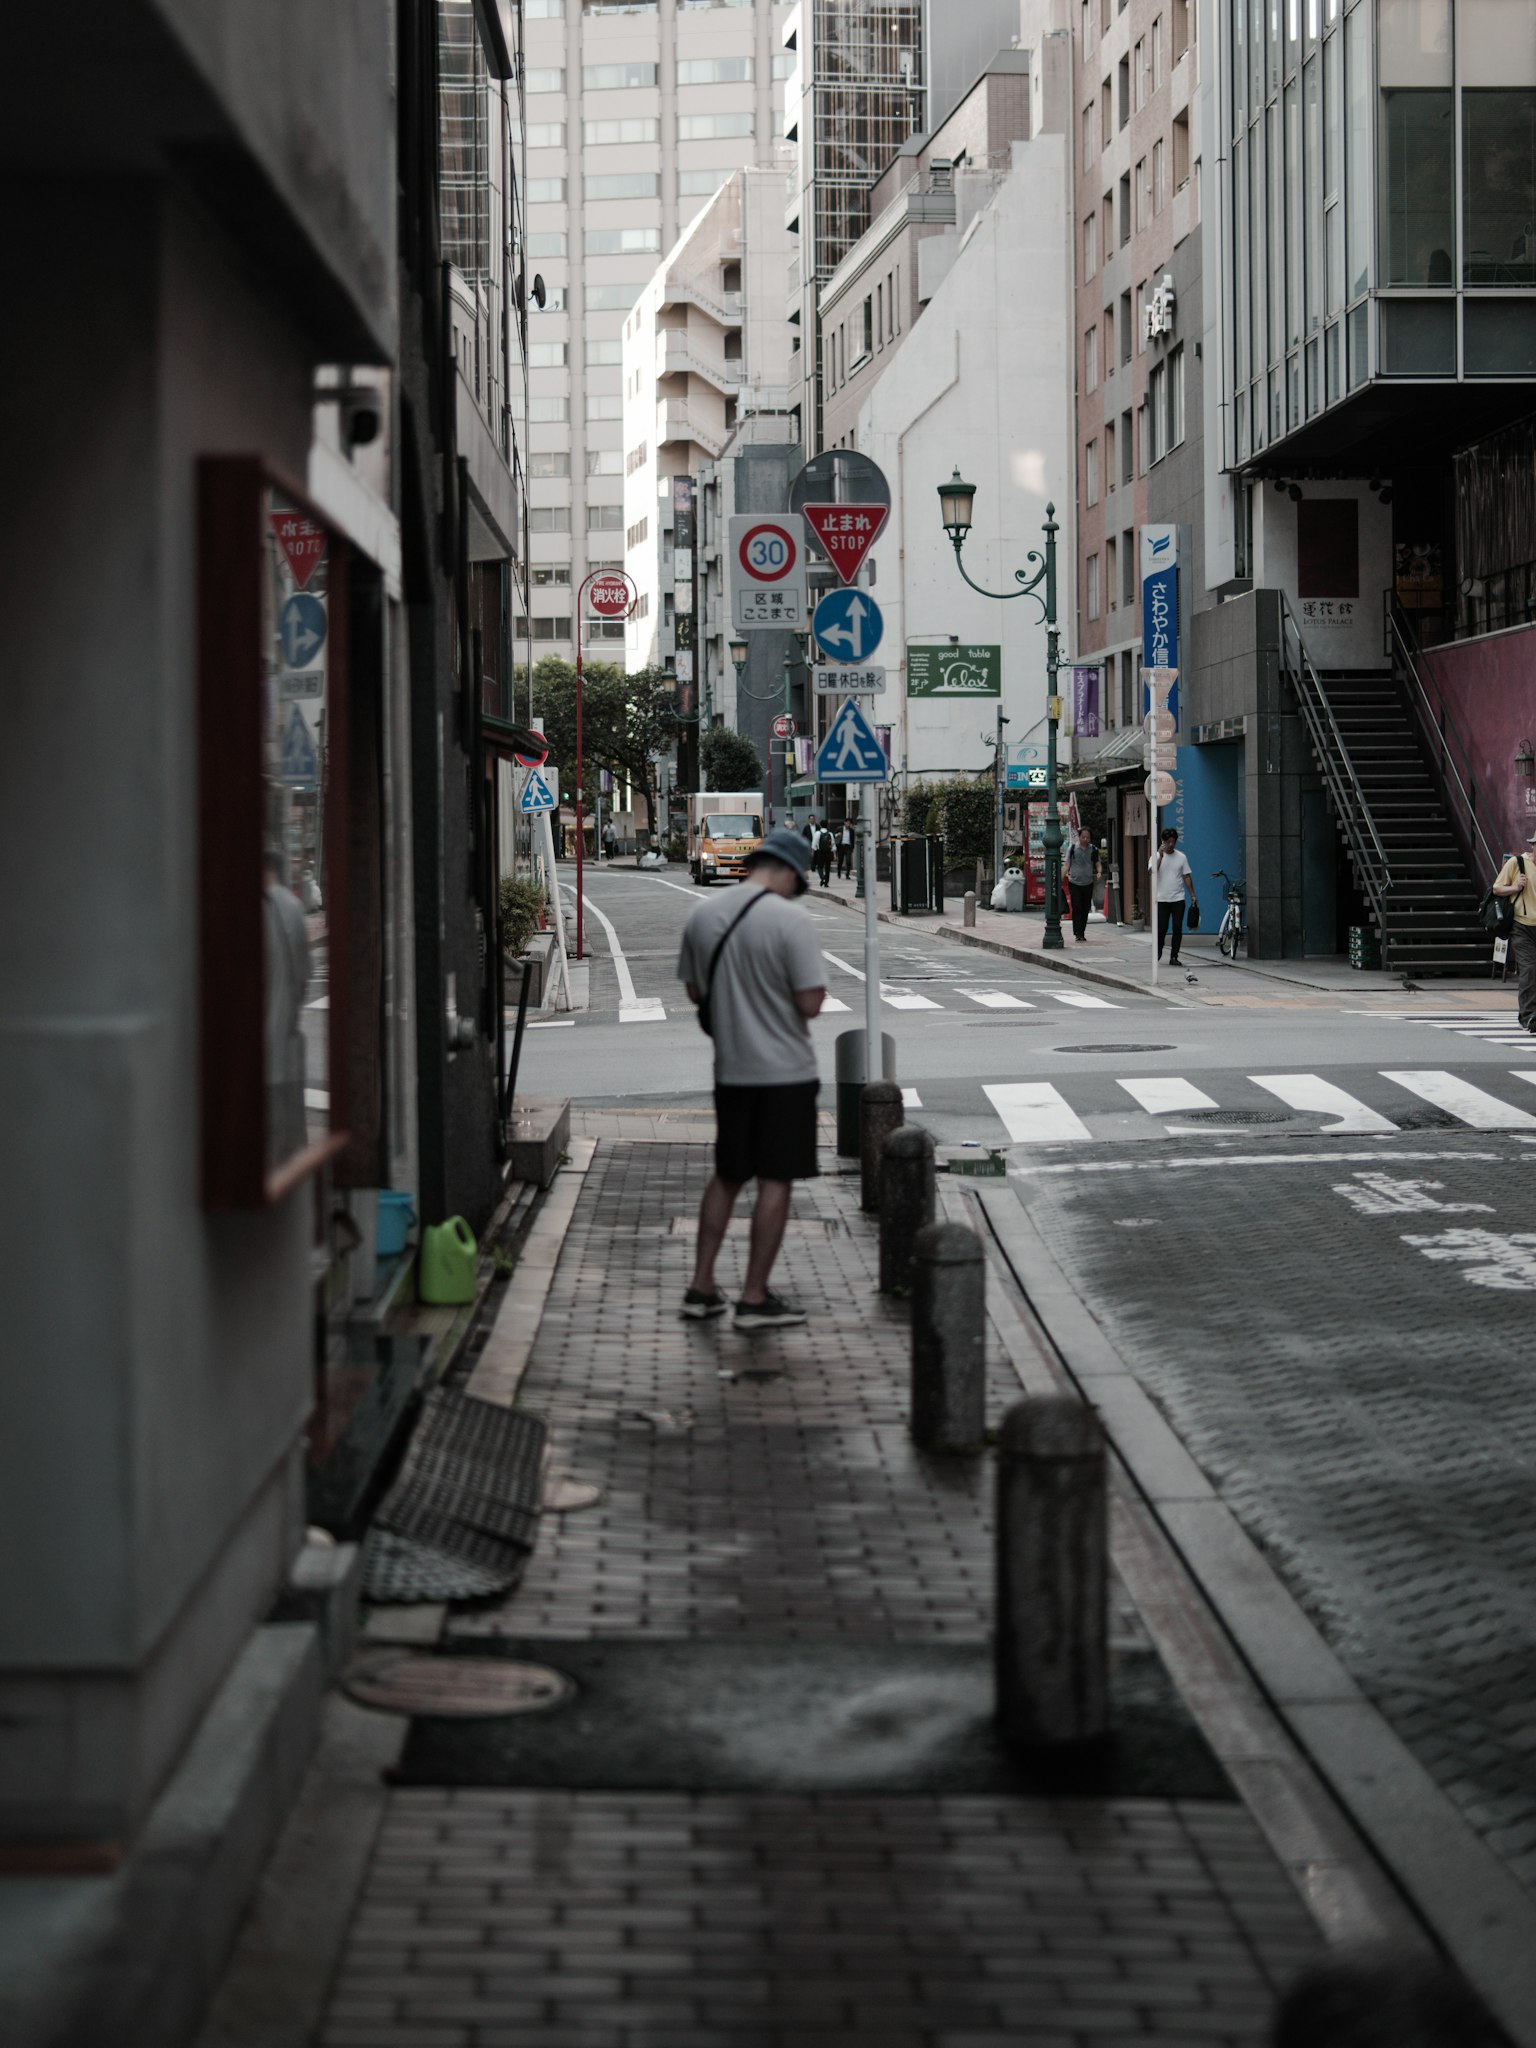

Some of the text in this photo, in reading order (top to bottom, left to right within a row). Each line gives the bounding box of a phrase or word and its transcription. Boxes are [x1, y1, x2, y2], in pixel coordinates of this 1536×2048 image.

[821, 513, 872, 531] 止まれ
[830, 536, 865, 550] STOP
[752, 540, 784, 566] 30
[593, 588, 626, 603] 消火栓
[754, 593, 784, 606] 区域
[744, 608, 796, 620] ここまで
[938, 648, 991, 660] good table
[910, 678, 920, 686] 2F
